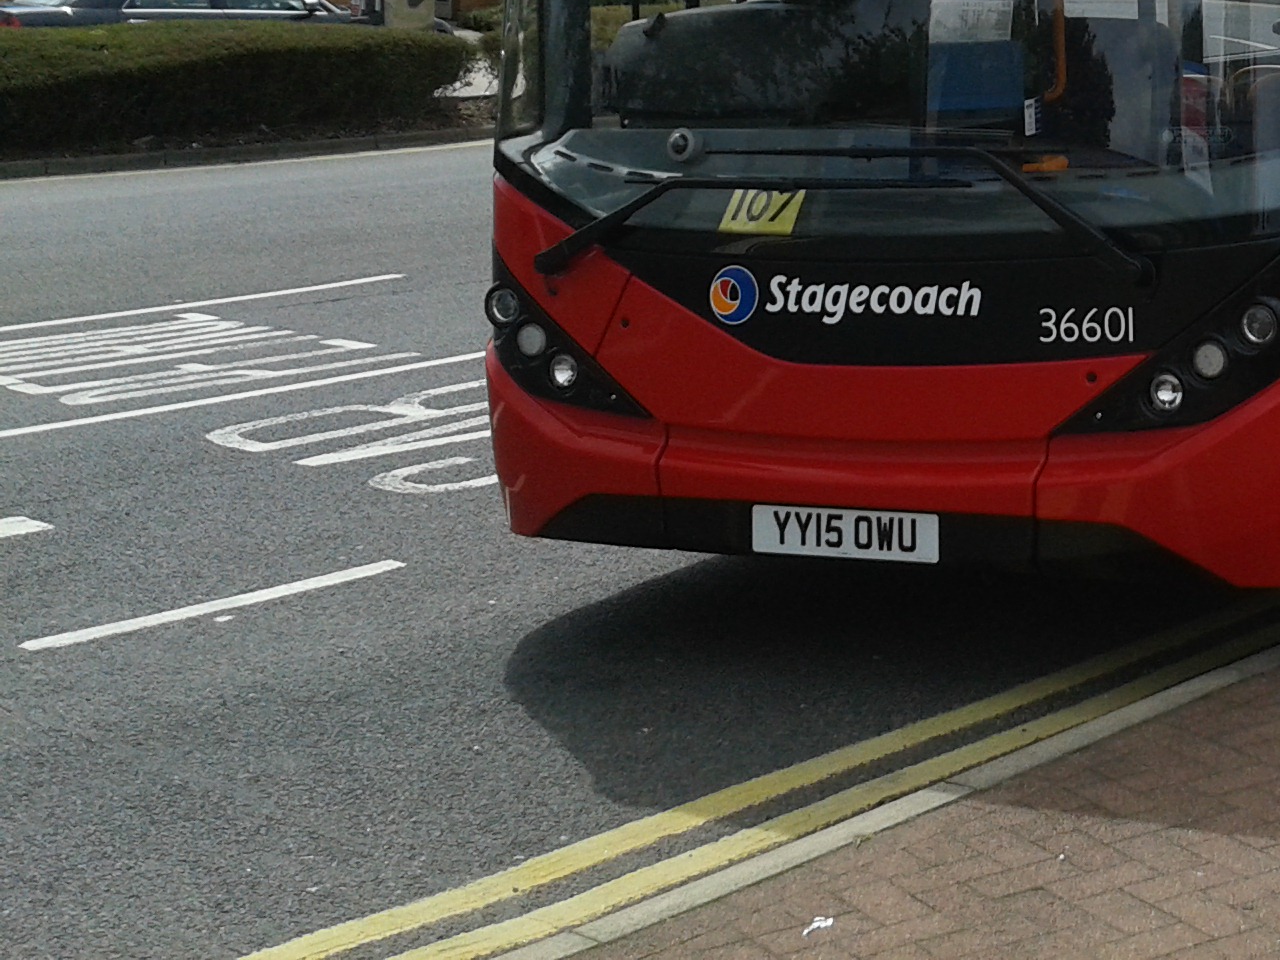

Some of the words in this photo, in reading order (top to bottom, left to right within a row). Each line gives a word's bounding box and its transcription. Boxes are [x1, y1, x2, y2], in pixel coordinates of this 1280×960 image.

[765, 274, 982, 324] Stagecoach
[1038, 306, 1135, 342] 36601
[774, 510, 844, 548] YY15
[854, 514, 917, 553] OWU
